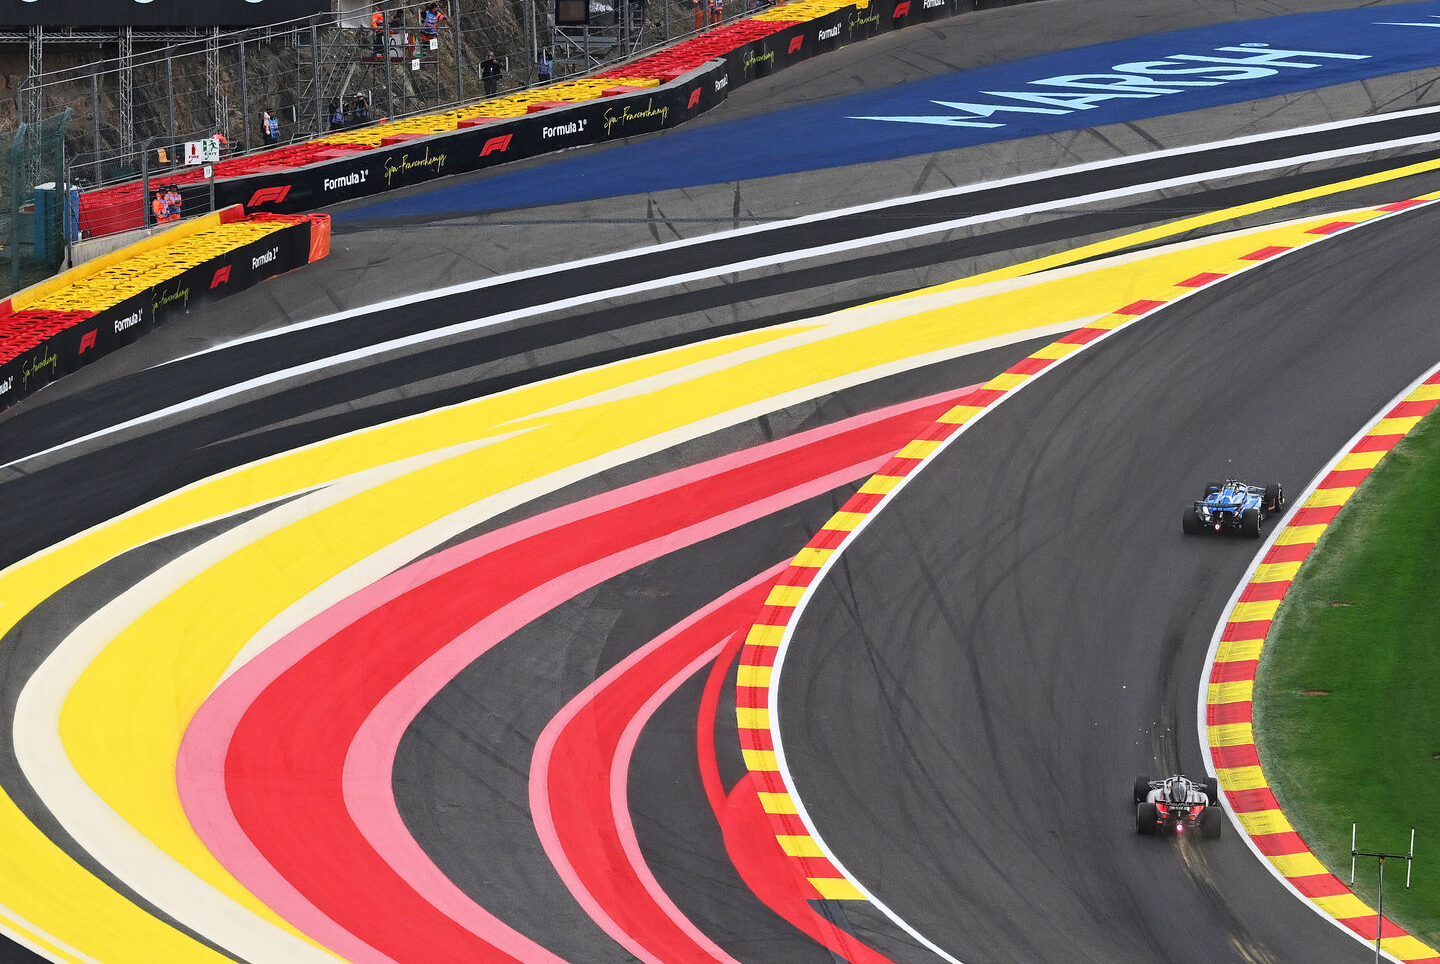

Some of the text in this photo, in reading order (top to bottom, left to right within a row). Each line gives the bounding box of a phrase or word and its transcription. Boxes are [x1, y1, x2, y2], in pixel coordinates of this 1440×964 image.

[843, 45, 1374, 129] MARSH
[542, 121, 577, 139] Formula
[324, 172, 360, 192] Formula
[252, 248, 273, 270] Formula
[115, 311, 138, 334] Formula
